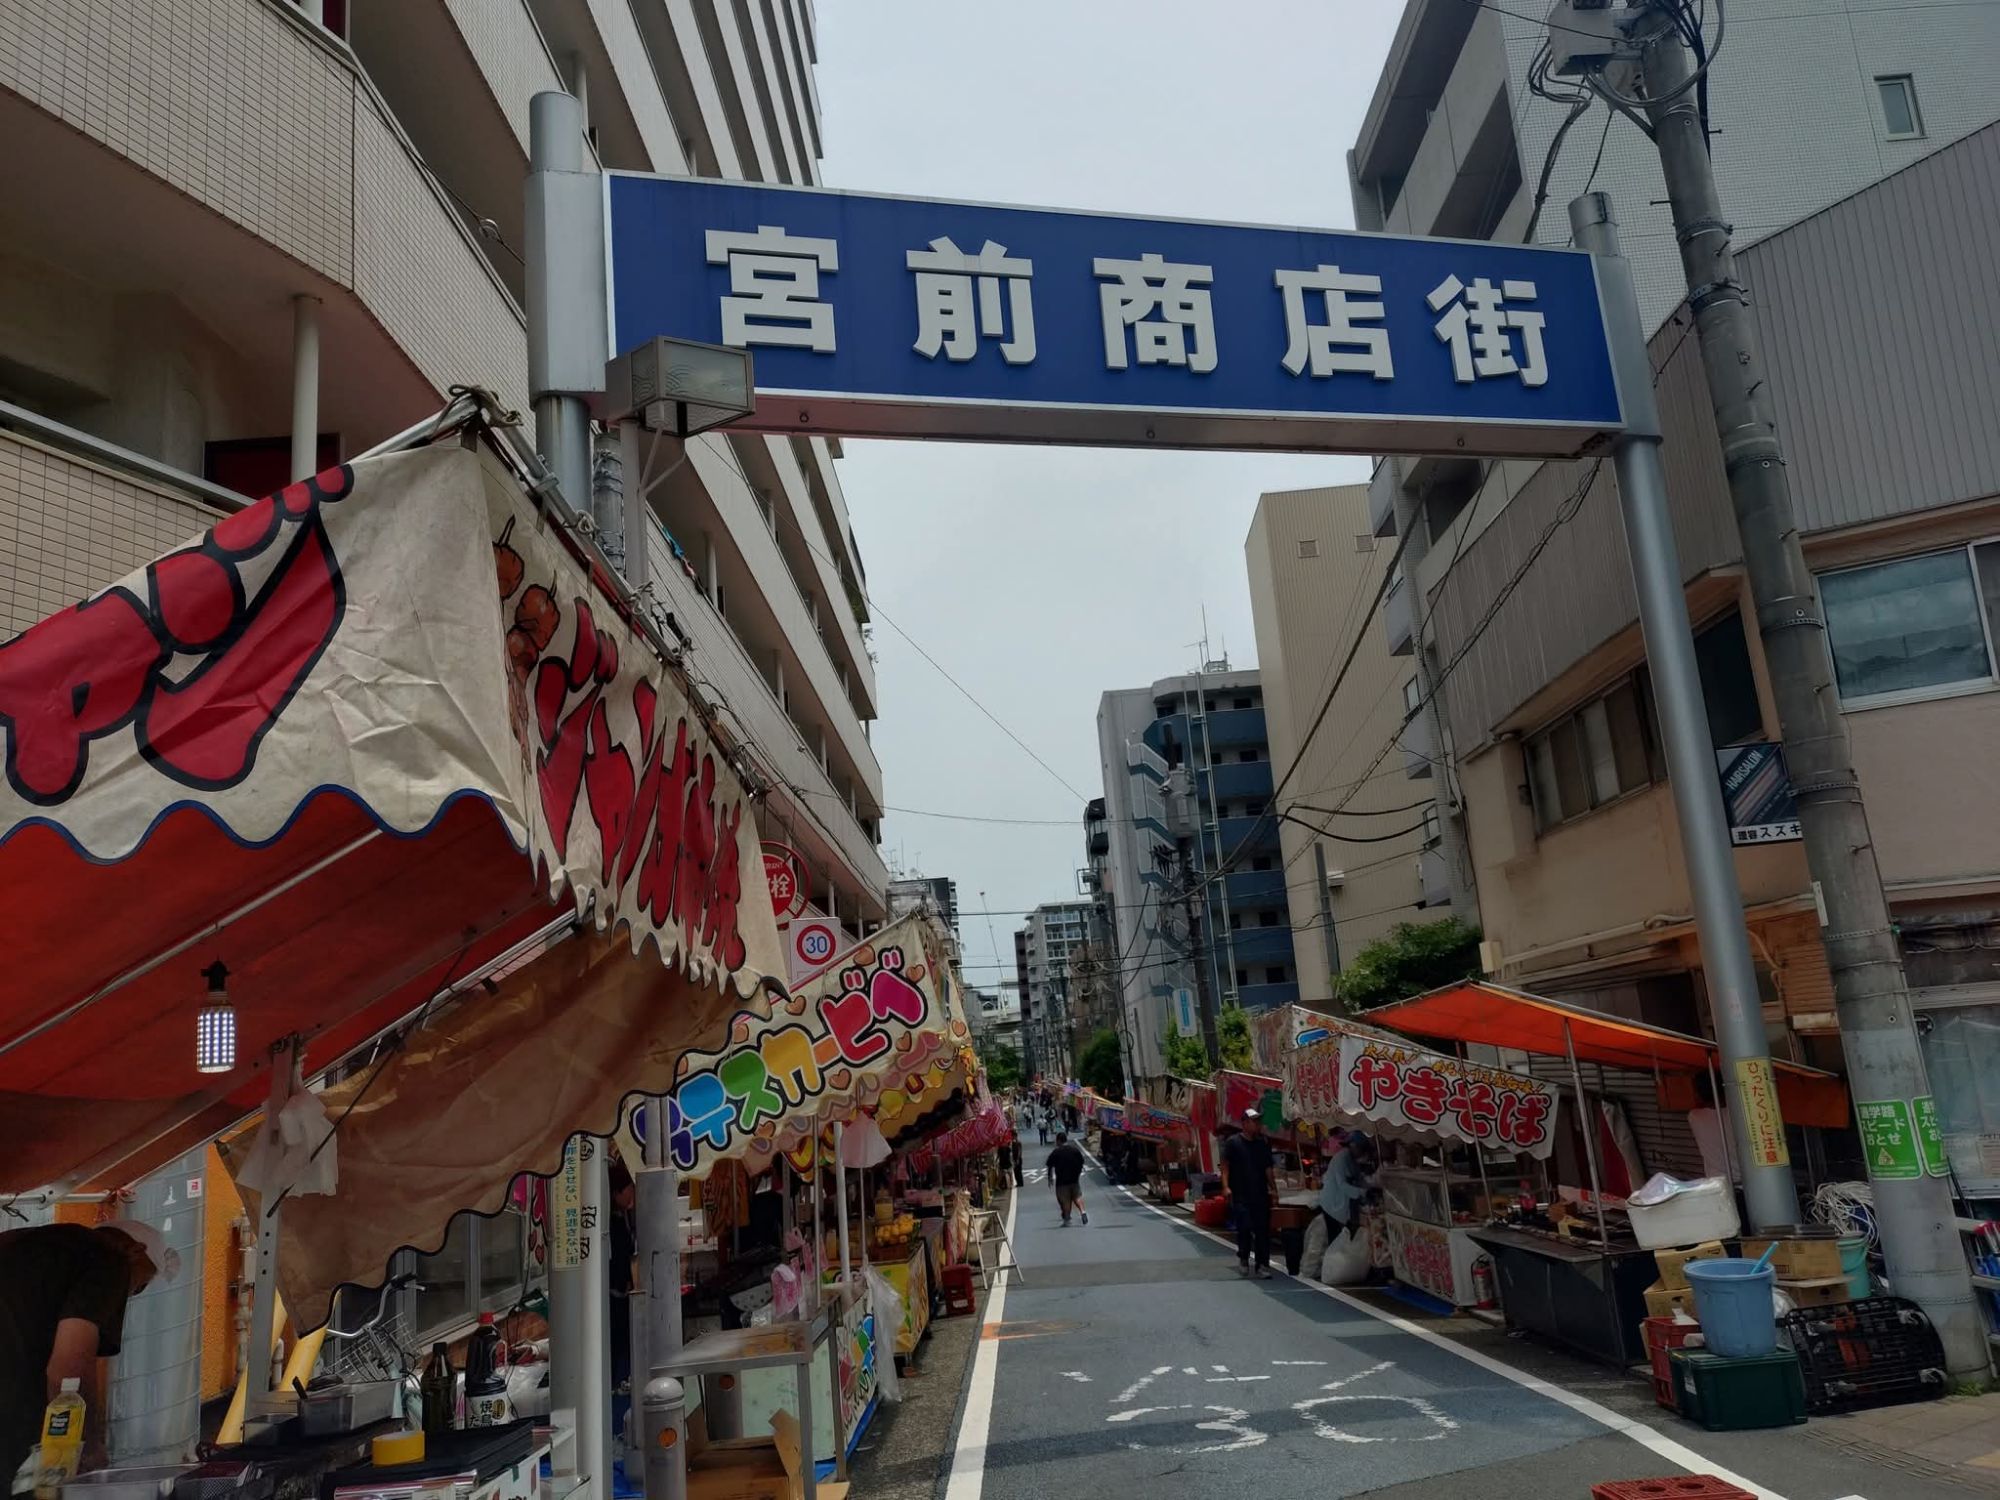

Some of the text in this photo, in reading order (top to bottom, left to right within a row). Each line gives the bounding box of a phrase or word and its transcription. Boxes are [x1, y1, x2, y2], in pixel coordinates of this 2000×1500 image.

[704, 225, 1547, 387] 宮前商店街
[805, 935, 828, 955] 30
[1350, 1054, 1553, 1148] やきそば
[1746, 1061, 1778, 1163] ひったくりに注意
[1105, 1394, 1461, 1454] 30
